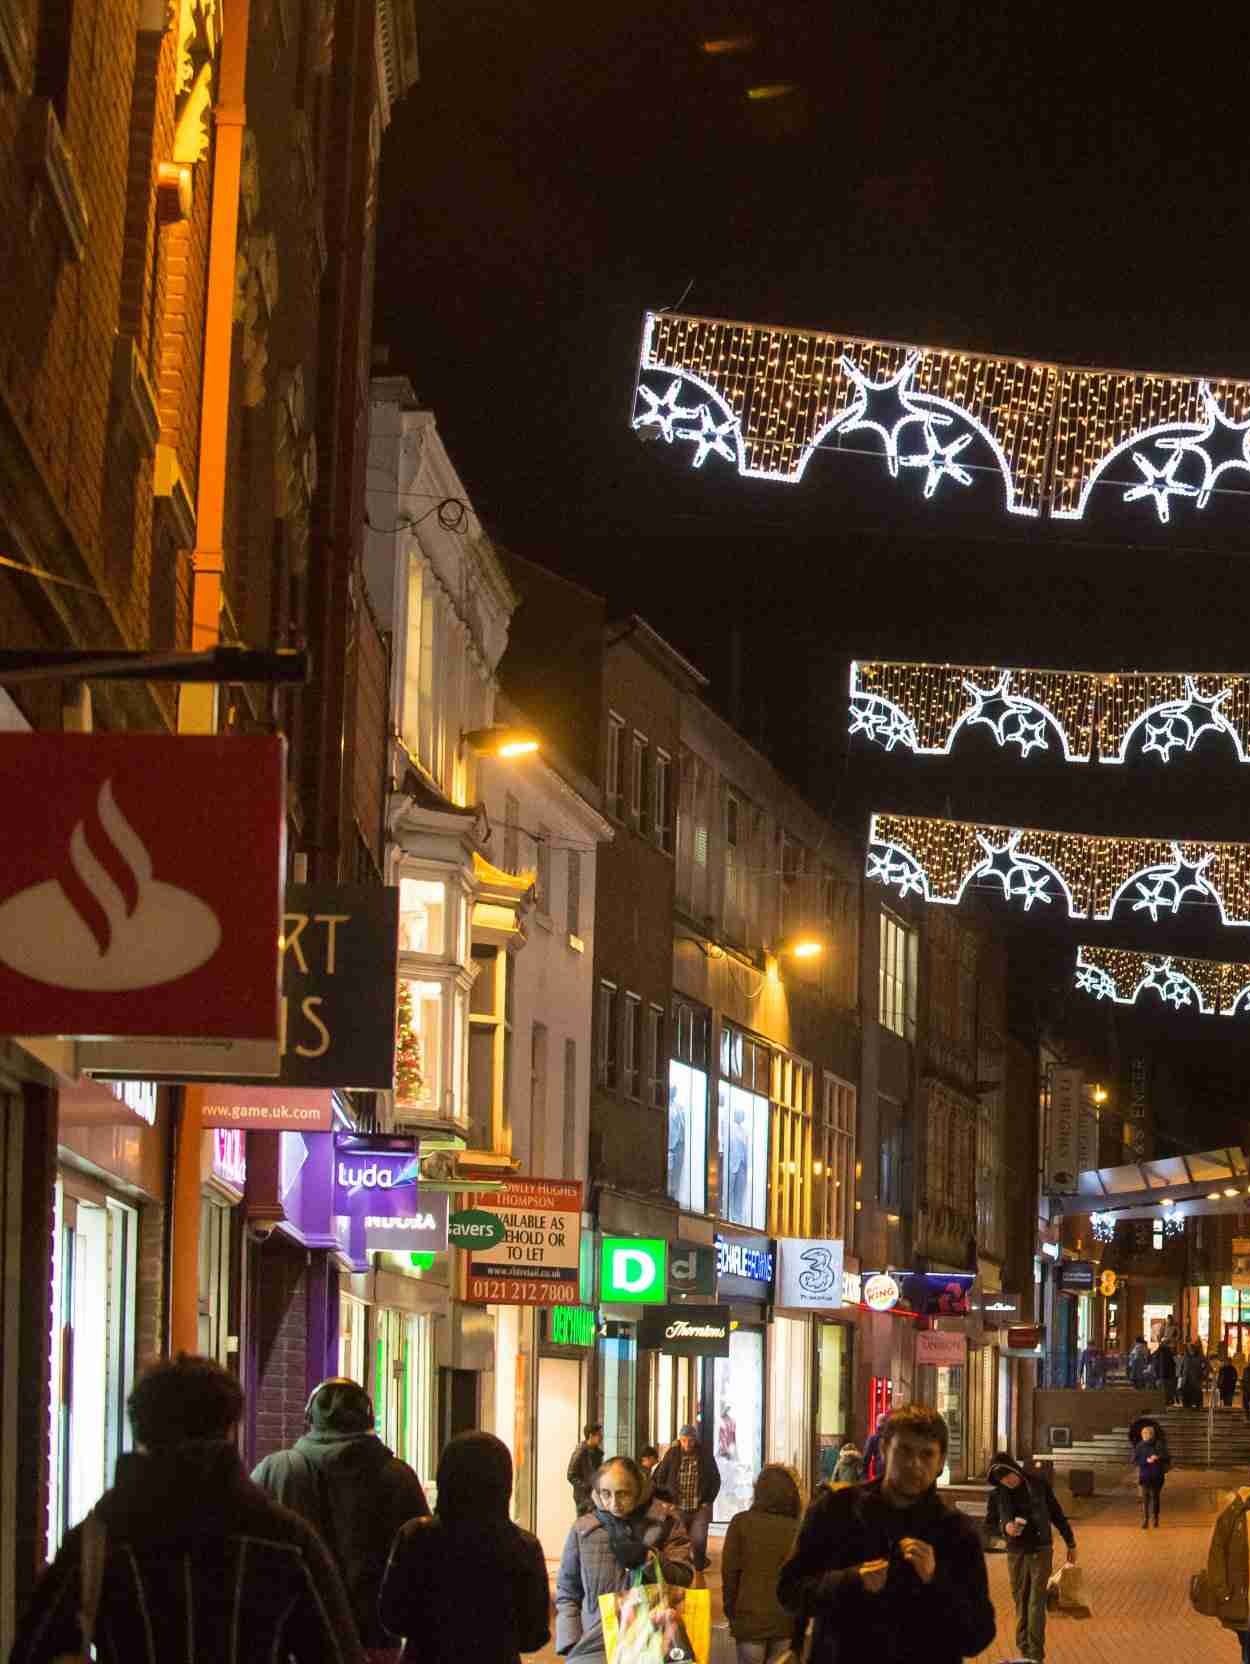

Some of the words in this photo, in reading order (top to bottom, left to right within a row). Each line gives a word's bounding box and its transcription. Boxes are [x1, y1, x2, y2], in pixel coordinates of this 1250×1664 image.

[539, 1183, 577, 1197] HUGHES
[496, 1193, 554, 1208] THOMPSON
[495, 1213, 546, 1229] VAILABLE
[550, 1217, 565, 1231] AS
[548, 1232, 566, 1247] OR
[507, 1246, 522, 1260] TO
[526, 1248, 545, 1262] LET
[612, 1249, 656, 1293] D
[799, 1247, 835, 1293] 3
[473, 1281, 507, 1298] 0121
[511, 1283, 537, 1299] 212
[541, 1284, 575, 1301] 7800
[665, 1320, 726, 1339] Thorntons
